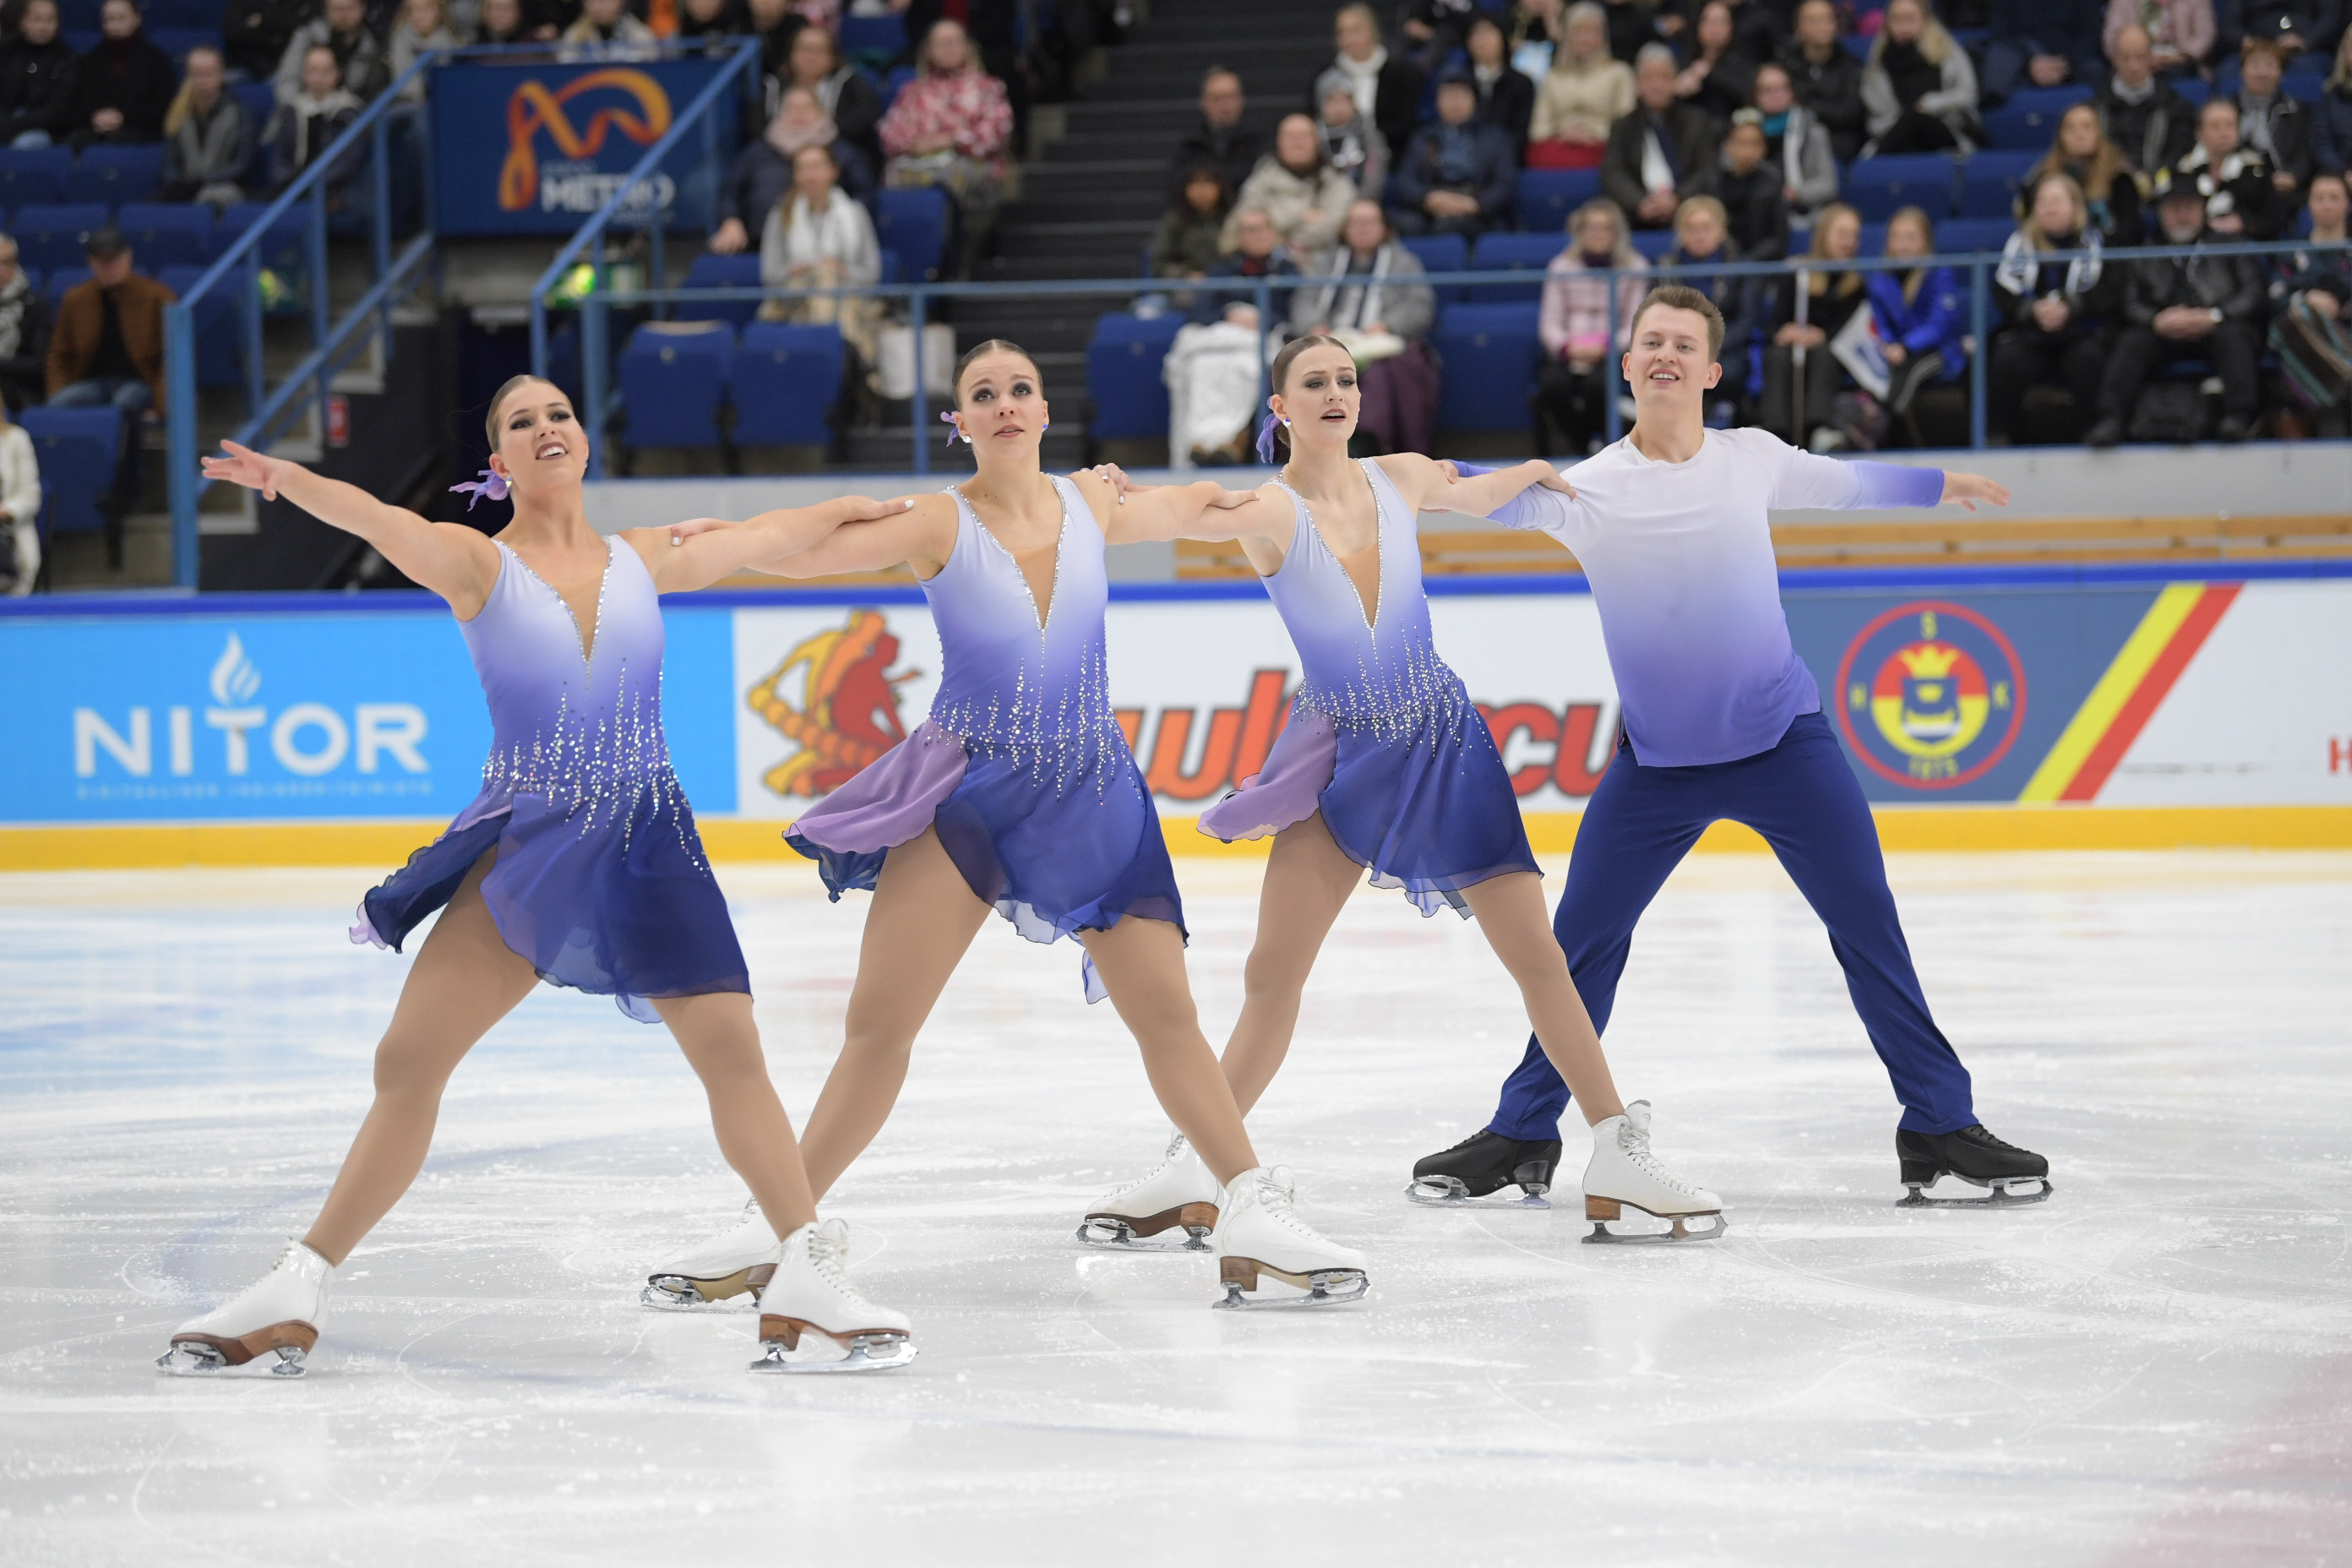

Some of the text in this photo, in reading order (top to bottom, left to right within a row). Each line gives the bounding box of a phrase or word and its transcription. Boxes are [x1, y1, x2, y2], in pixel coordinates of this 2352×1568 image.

[541, 172, 676, 214] METRO
[1921, 610, 1937, 640] S
[74, 702, 430, 777] NITOR
